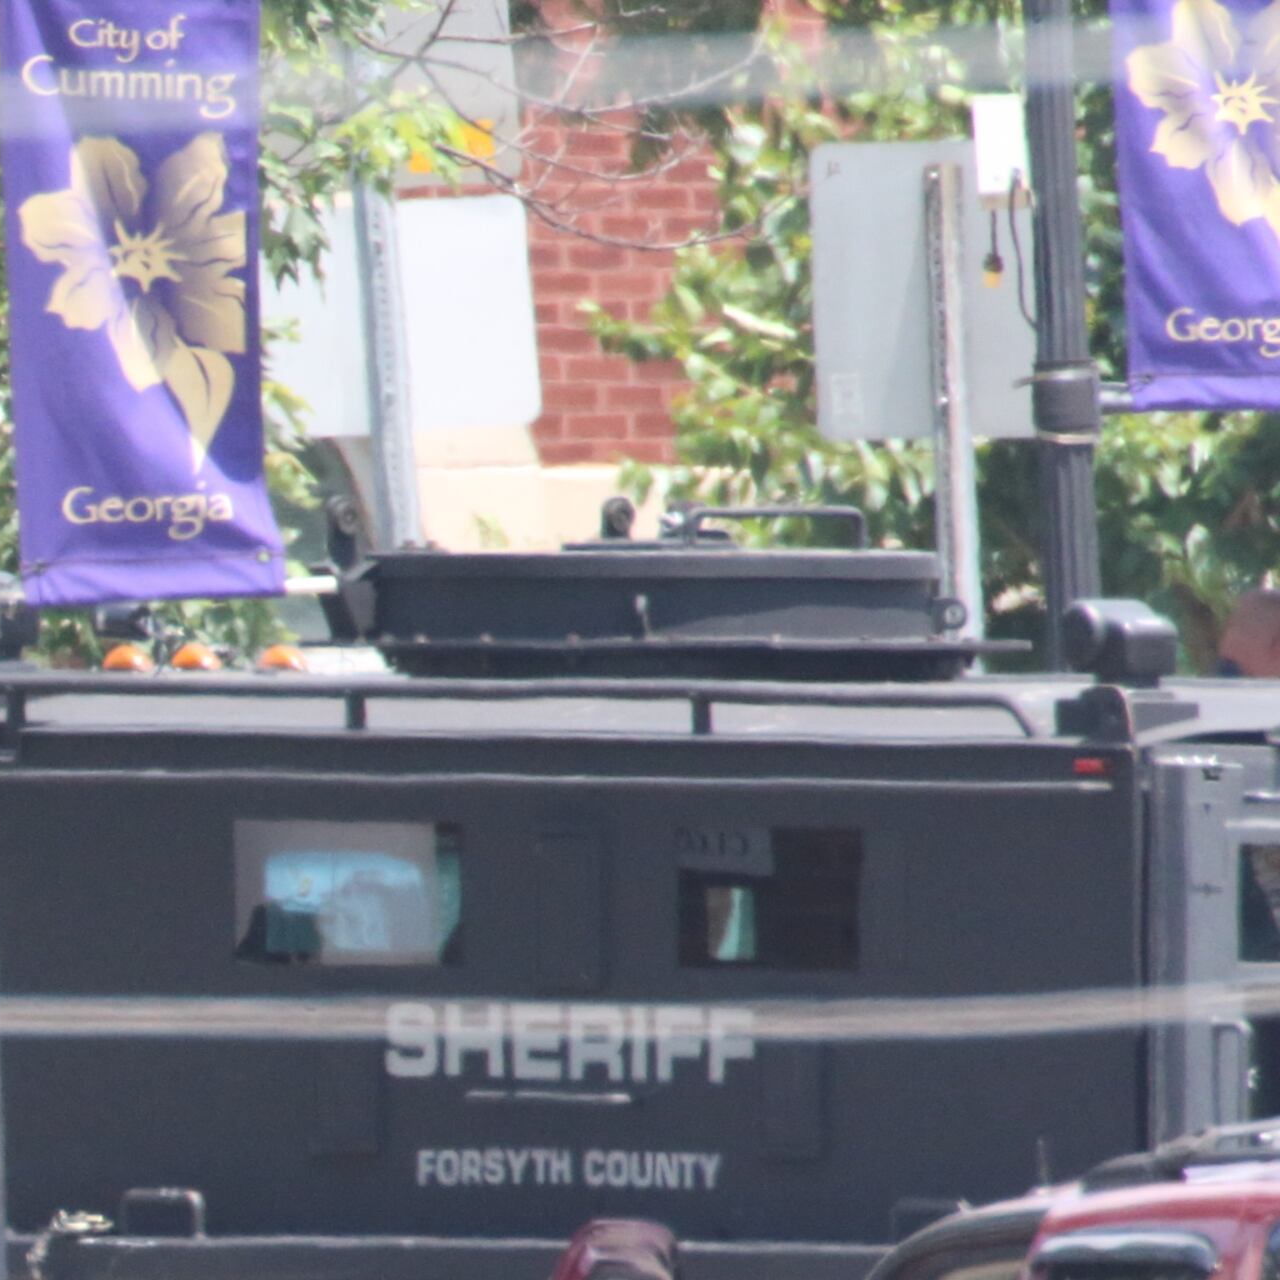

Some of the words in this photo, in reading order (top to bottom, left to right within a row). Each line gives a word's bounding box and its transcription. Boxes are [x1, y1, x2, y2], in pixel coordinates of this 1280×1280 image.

[68, 17, 140, 63] City
[145, 13, 187, 50] of
[21, 54, 237, 119] Cumming
[61, 480, 234, 540] Georgia
[384, 1001, 756, 1084] SHERIFF
[416, 1147, 572, 1187] FORSYTH
[583, 1150, 721, 1190] COUNTY
